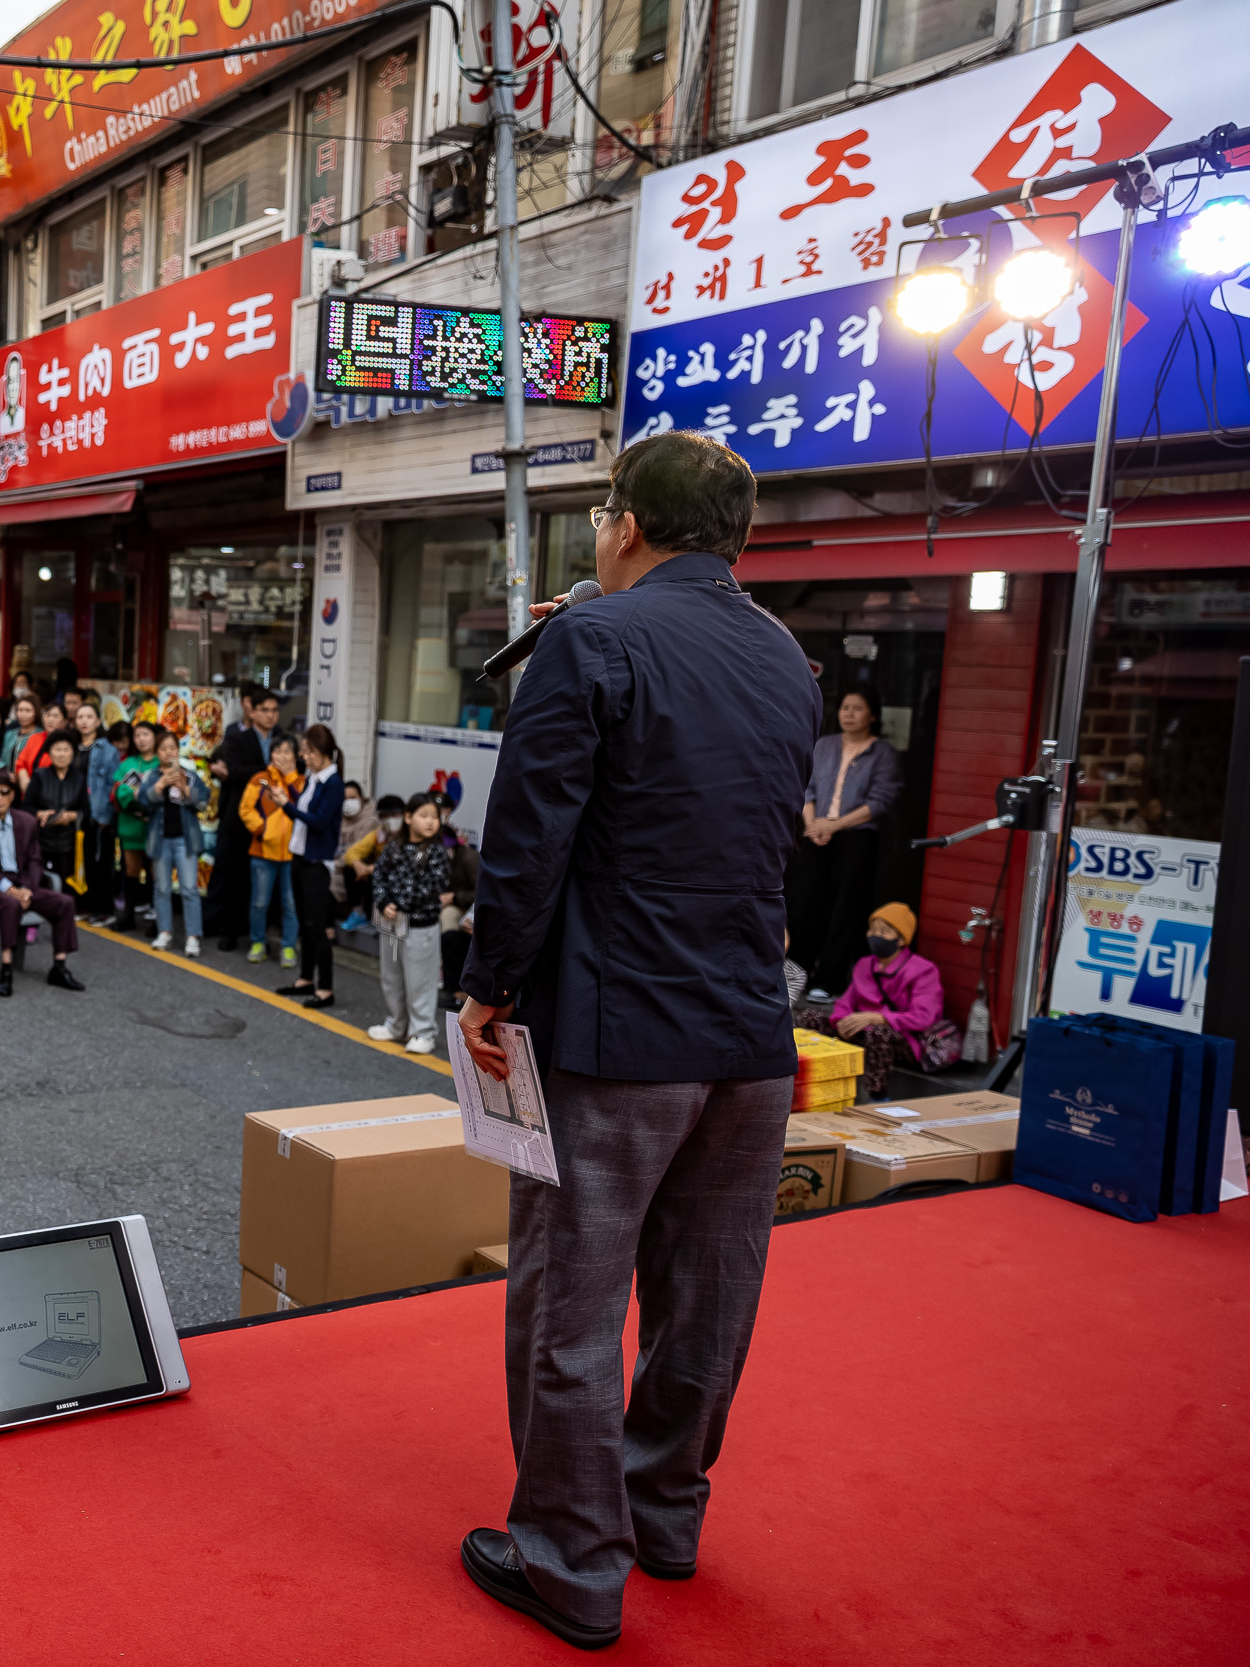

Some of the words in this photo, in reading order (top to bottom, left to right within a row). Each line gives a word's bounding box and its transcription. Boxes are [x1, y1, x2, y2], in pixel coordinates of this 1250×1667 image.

[64, 131, 108, 171] China
[105, 68, 201, 149] Restaurant
[671, 128, 876, 250] 원조
[37, 292, 277, 413] 牛肉面大王
[635, 305, 883, 401] 양꼬치거리
[37, 407, 108, 457] 우육면대왕
[1084, 843, 1220, 886] SBS-T
[1086, 909, 1144, 933] 생방송
[1076, 926, 1210, 1004] 투데
[58, 1312, 86, 1321] ELF
[56, 1401, 79, 1410] SAMSUNG
